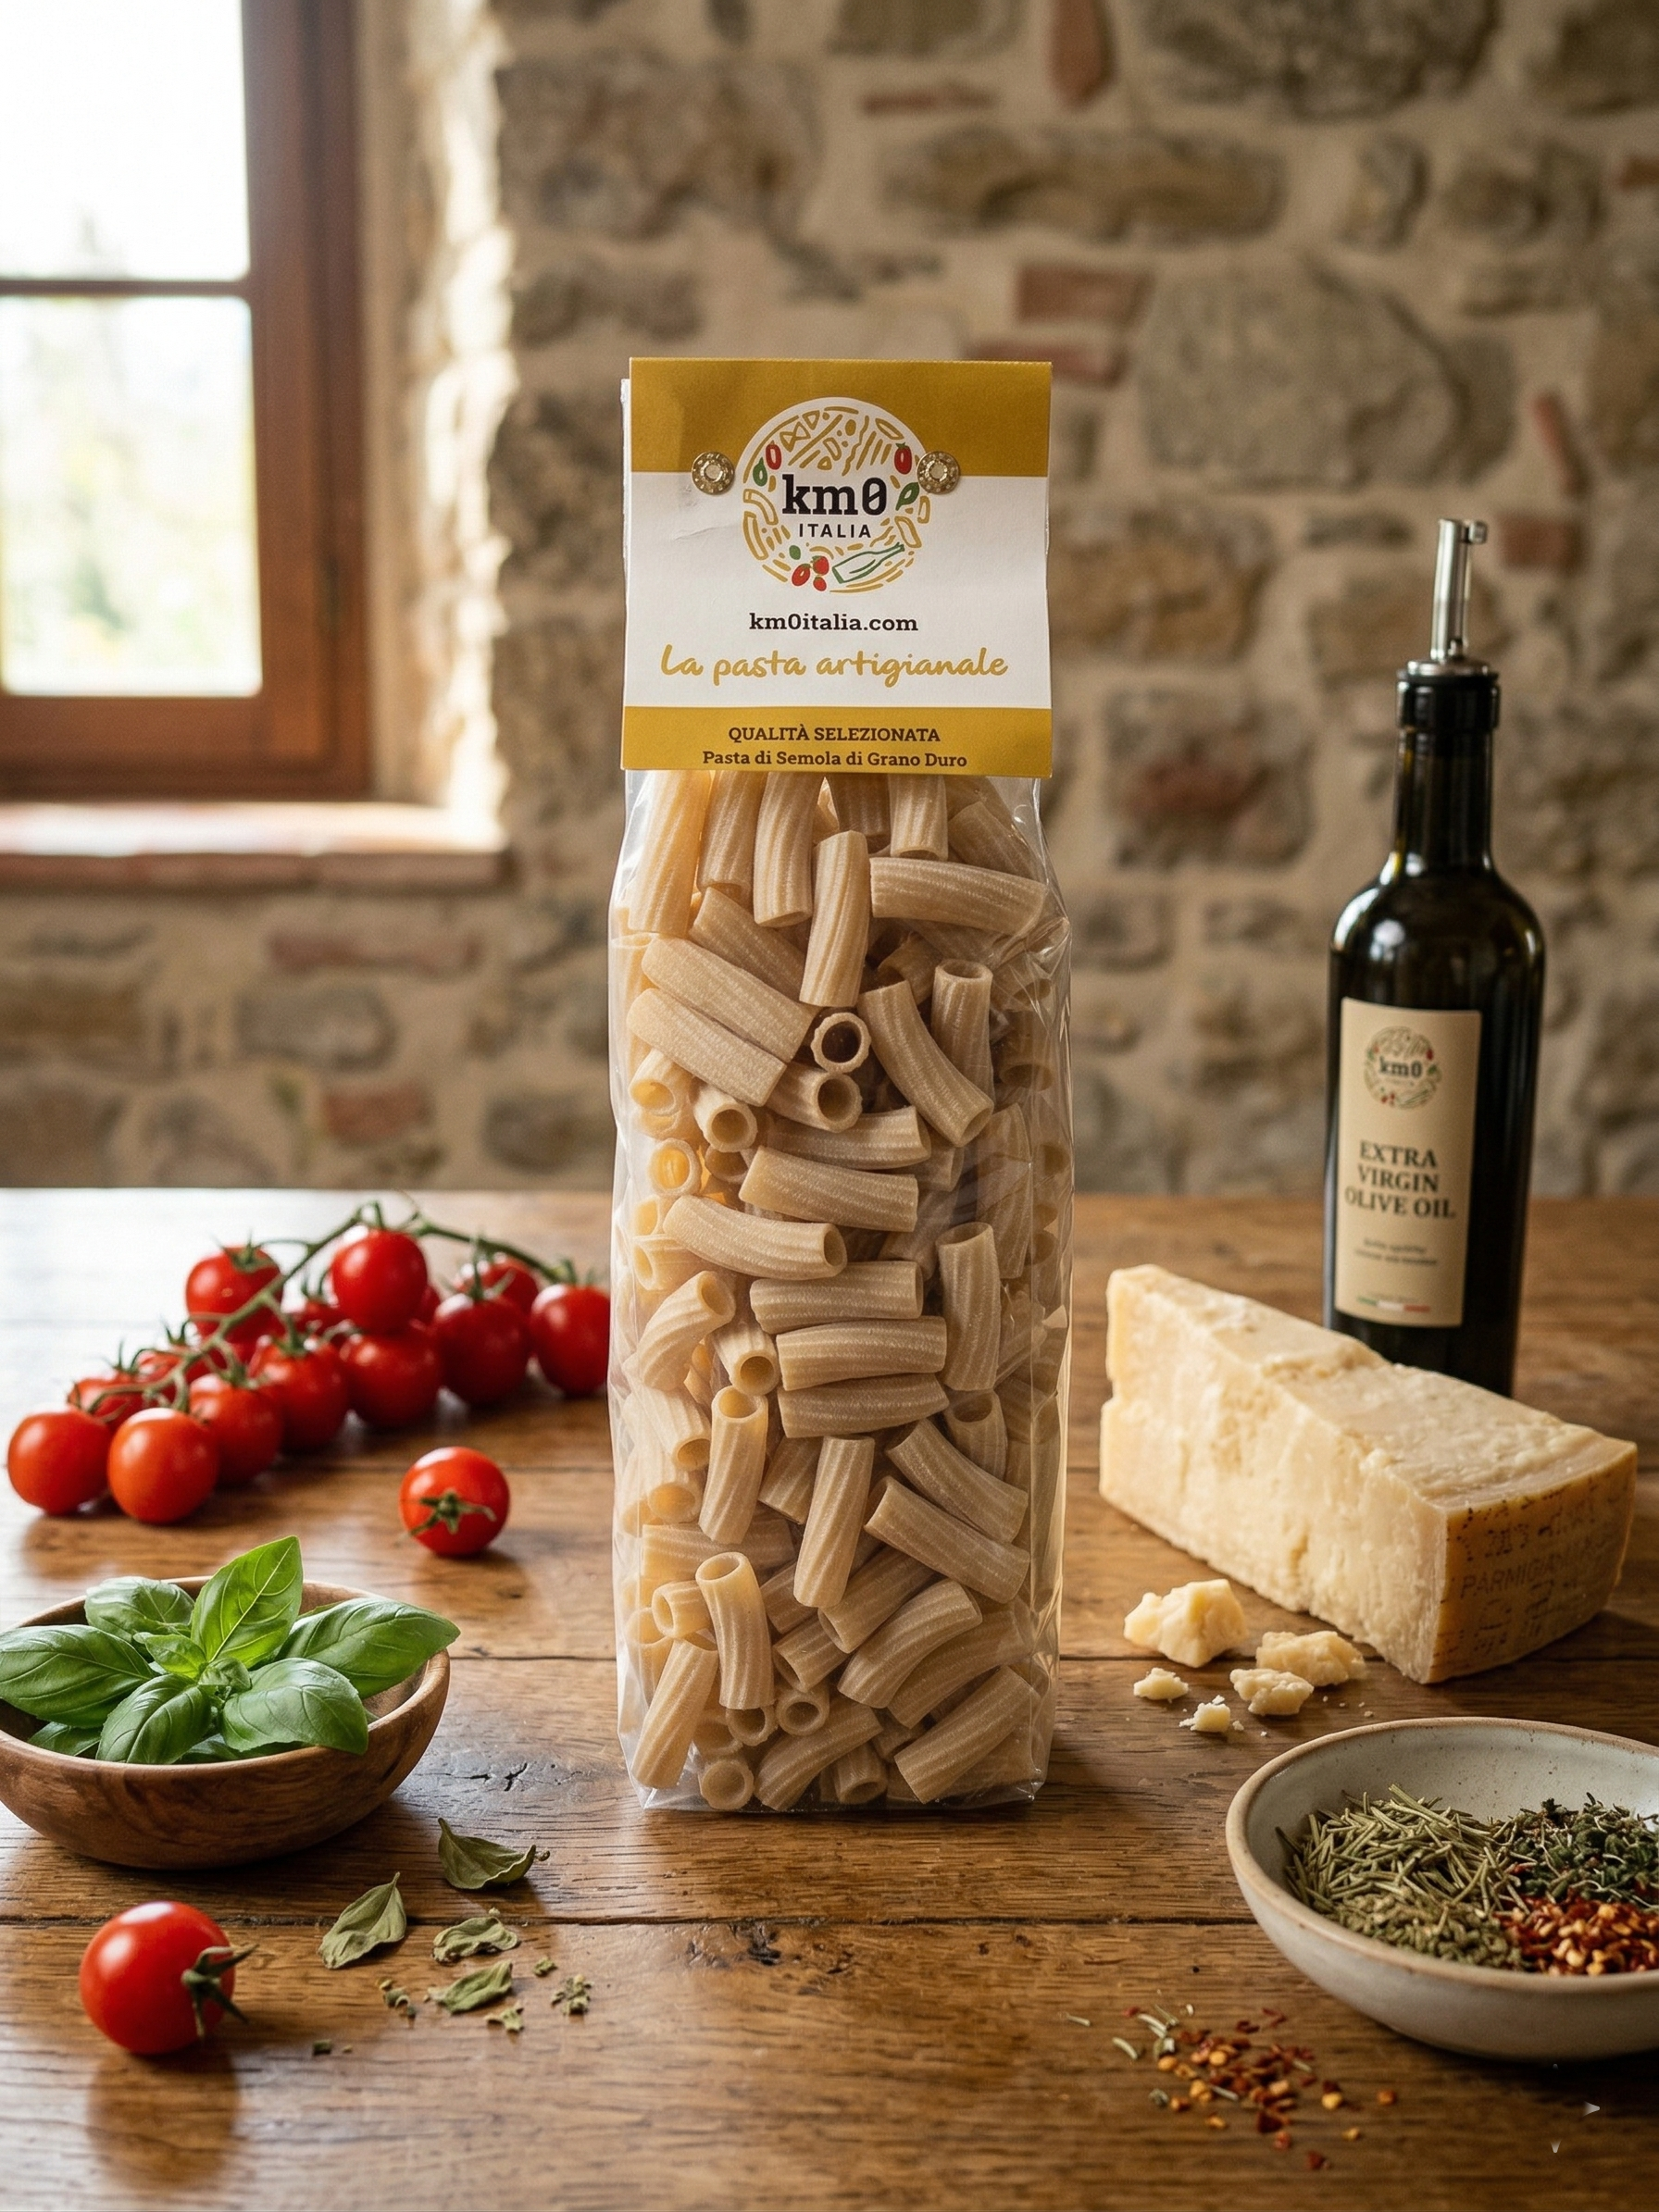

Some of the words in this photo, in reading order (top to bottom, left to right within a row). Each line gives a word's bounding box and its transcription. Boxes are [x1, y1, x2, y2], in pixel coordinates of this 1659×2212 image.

[781, 472, 888, 516] km0
[799, 523, 871, 539] ITALIA
[749, 612, 919, 631] km0italia.com
[660, 643, 705, 677] La
[713, 650, 807, 687] pasta
[816, 647, 1010, 689] artigianale
[728, 723, 809, 743] QUALITÀ
[814, 727, 942, 742] SELEZIONATA
[702, 751, 751, 764] Pasta
[755, 750, 772, 764] di
[776, 751, 842, 765] Semola
[845, 751, 864, 766] di
[867, 752, 921, 767] Grano
[924, 752, 967, 767] Duro
[1378, 1055, 1423, 1079] km0
[1360, 1140, 1437, 1168] EXTRA
[1357, 1163, 1439, 1193] VIRGIN
[1344, 1186, 1407, 1216] OLIVE
[1413, 1198, 1457, 1220] OIL
